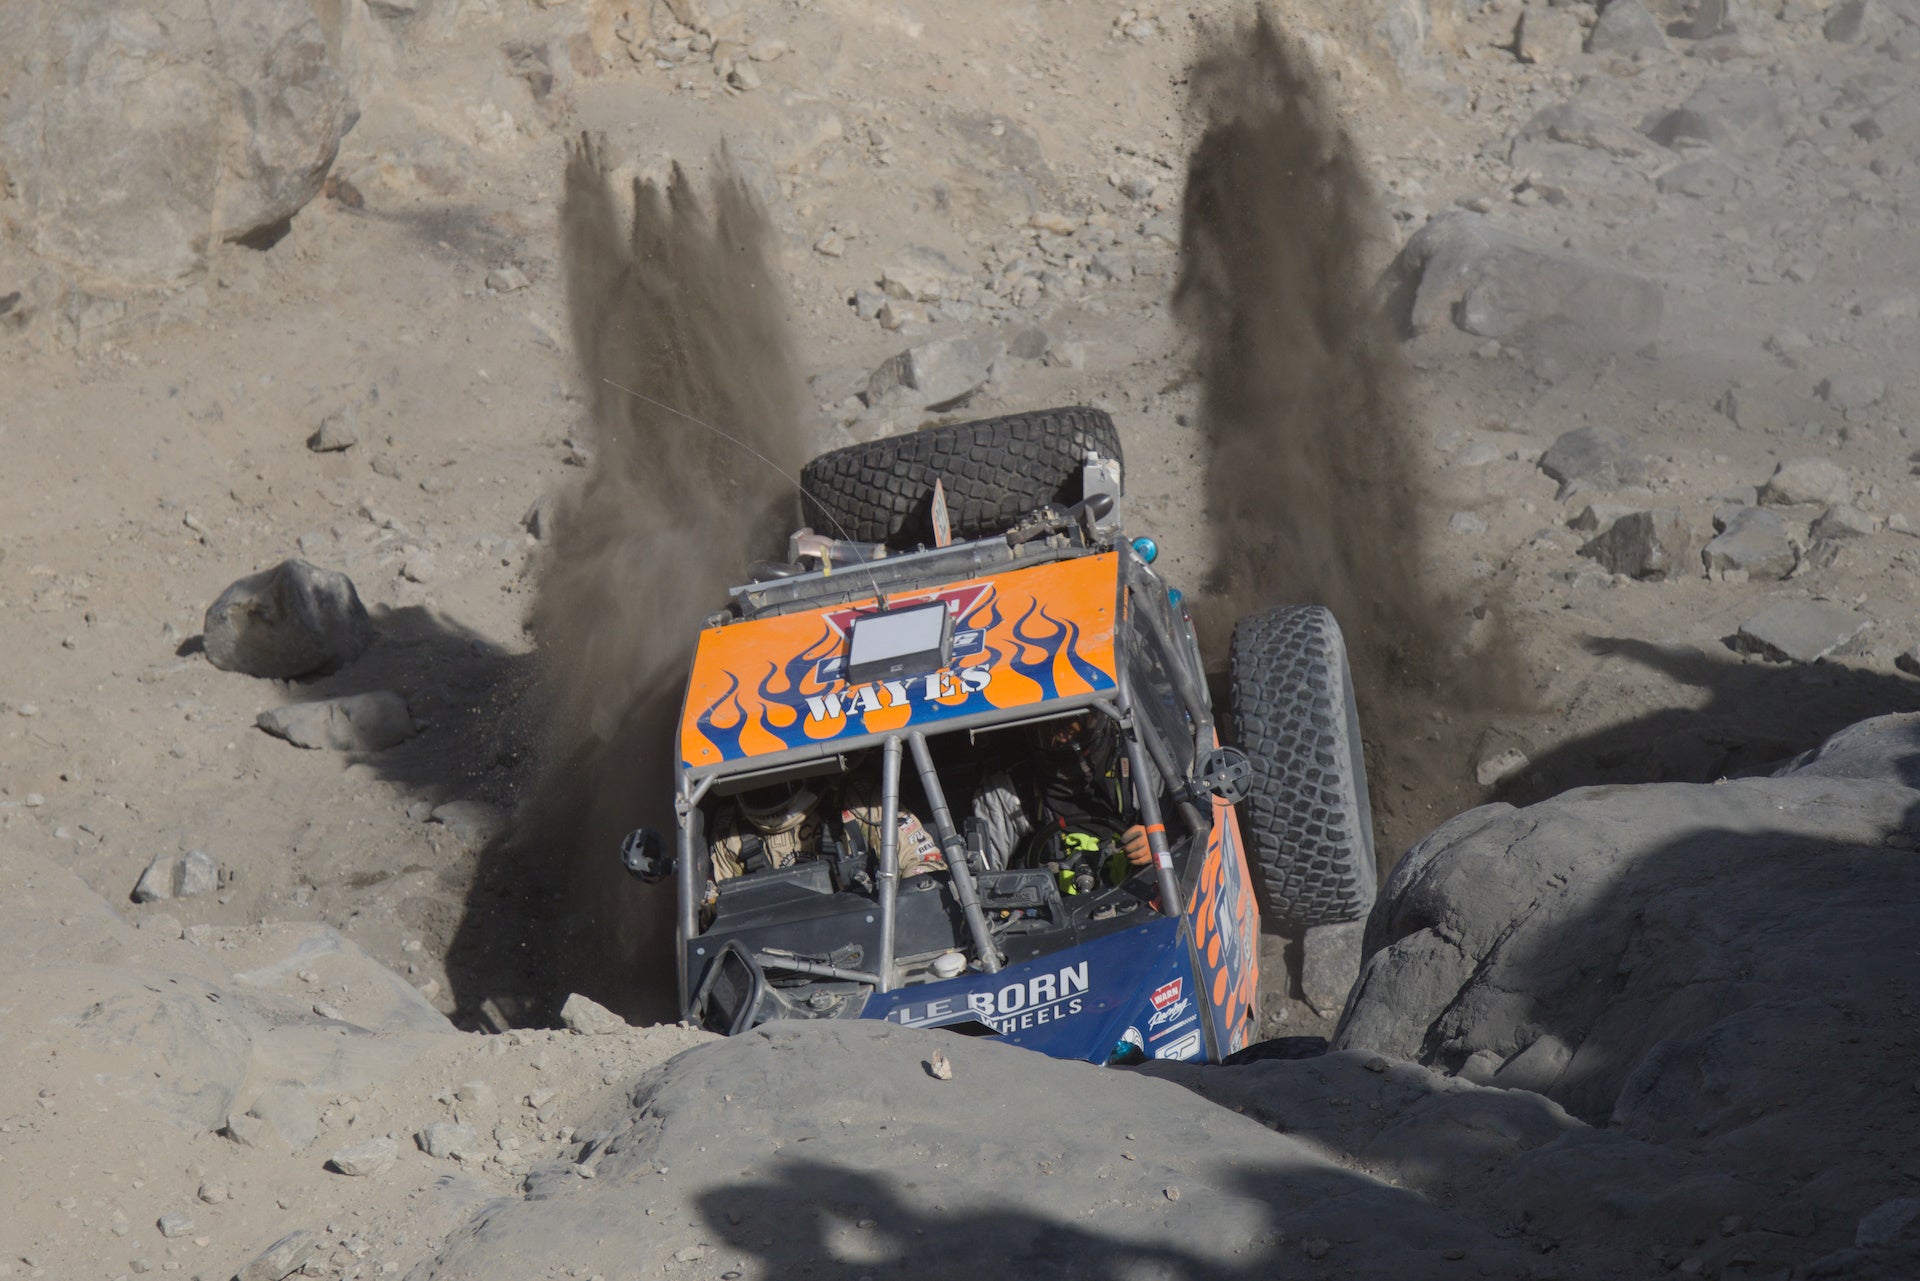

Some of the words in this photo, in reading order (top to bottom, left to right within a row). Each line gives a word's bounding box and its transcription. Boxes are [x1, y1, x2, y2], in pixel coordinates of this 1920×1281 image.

[804, 664, 992, 722] WAYES
[967, 960, 1089, 1017] BORN
[1154, 987, 1179, 1005] WARN
[980, 998, 1083, 1036] WHEELS
